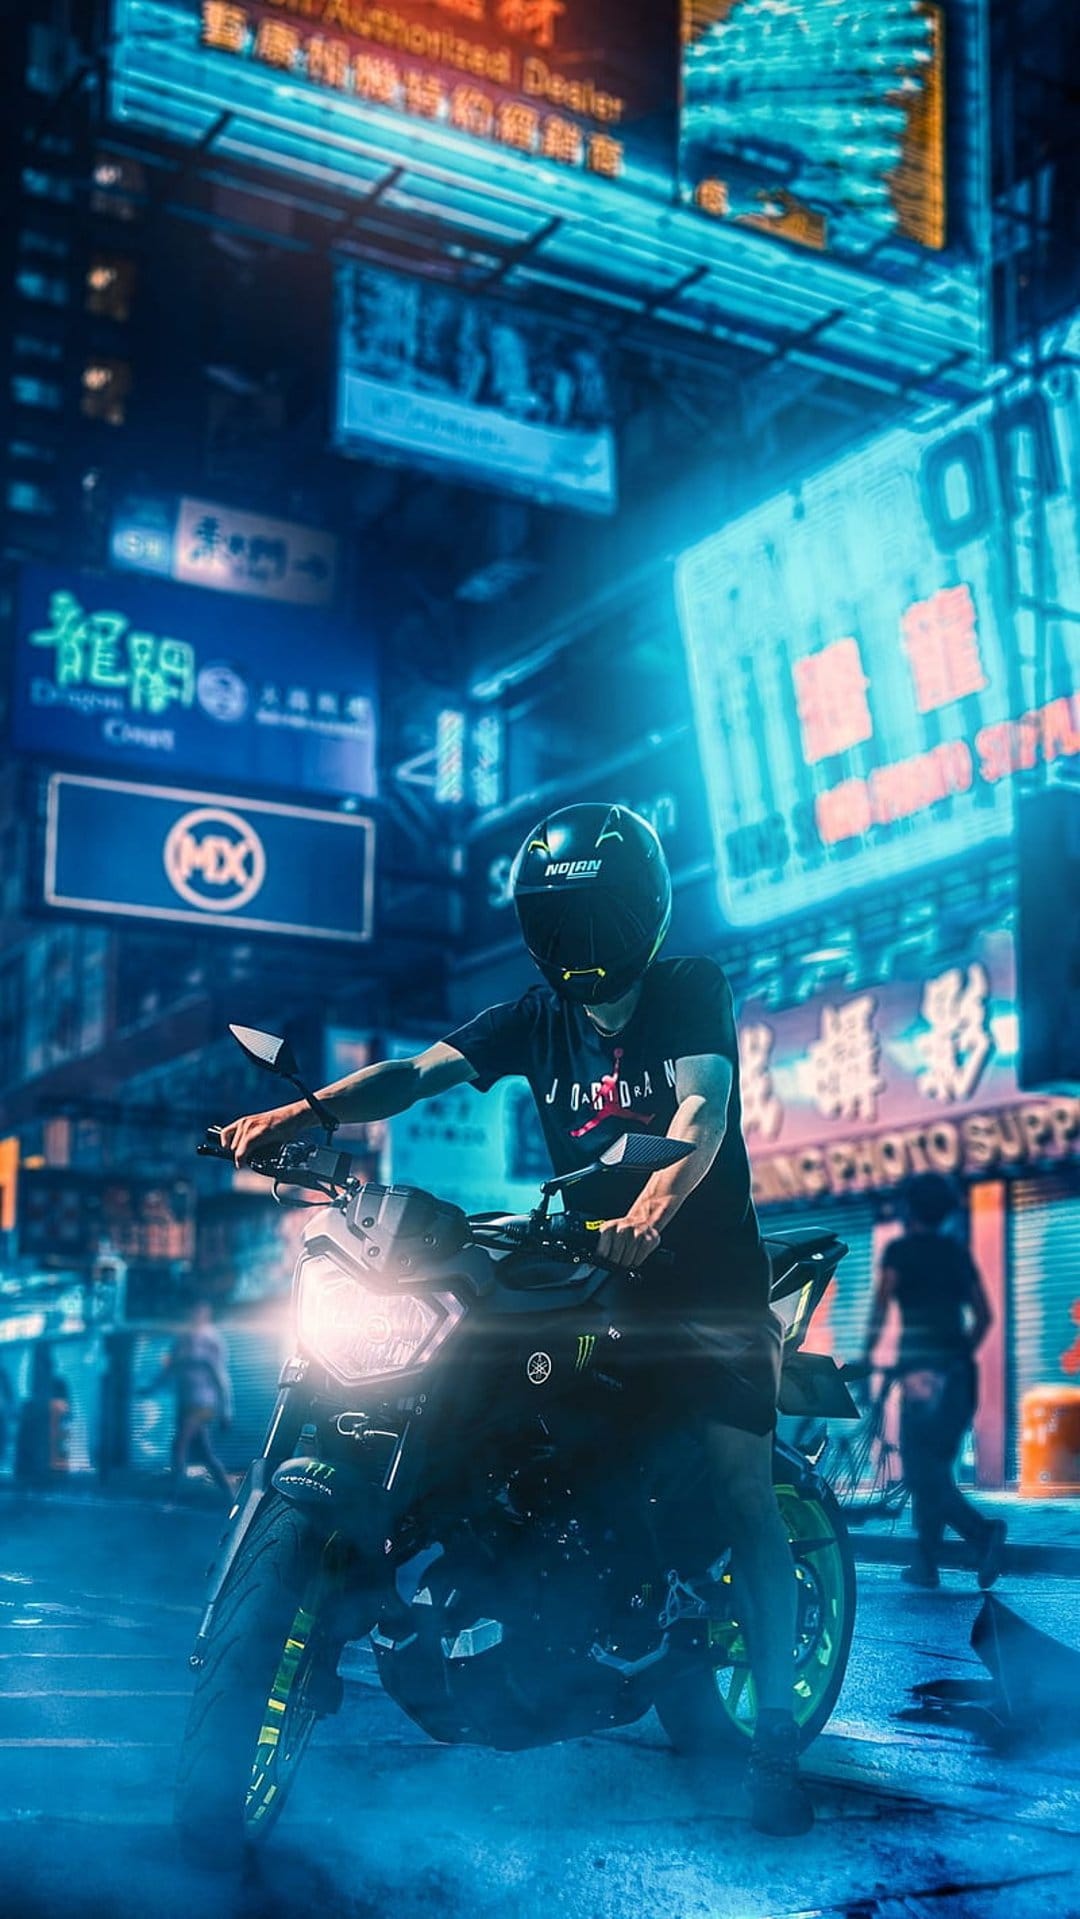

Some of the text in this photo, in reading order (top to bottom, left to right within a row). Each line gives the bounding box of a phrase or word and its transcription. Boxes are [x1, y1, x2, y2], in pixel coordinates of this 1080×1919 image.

[522, 56, 623, 122] Dealer
[544, 859, 602, 877] NOLAN
[827, 1123, 959, 1192] PHOTO
